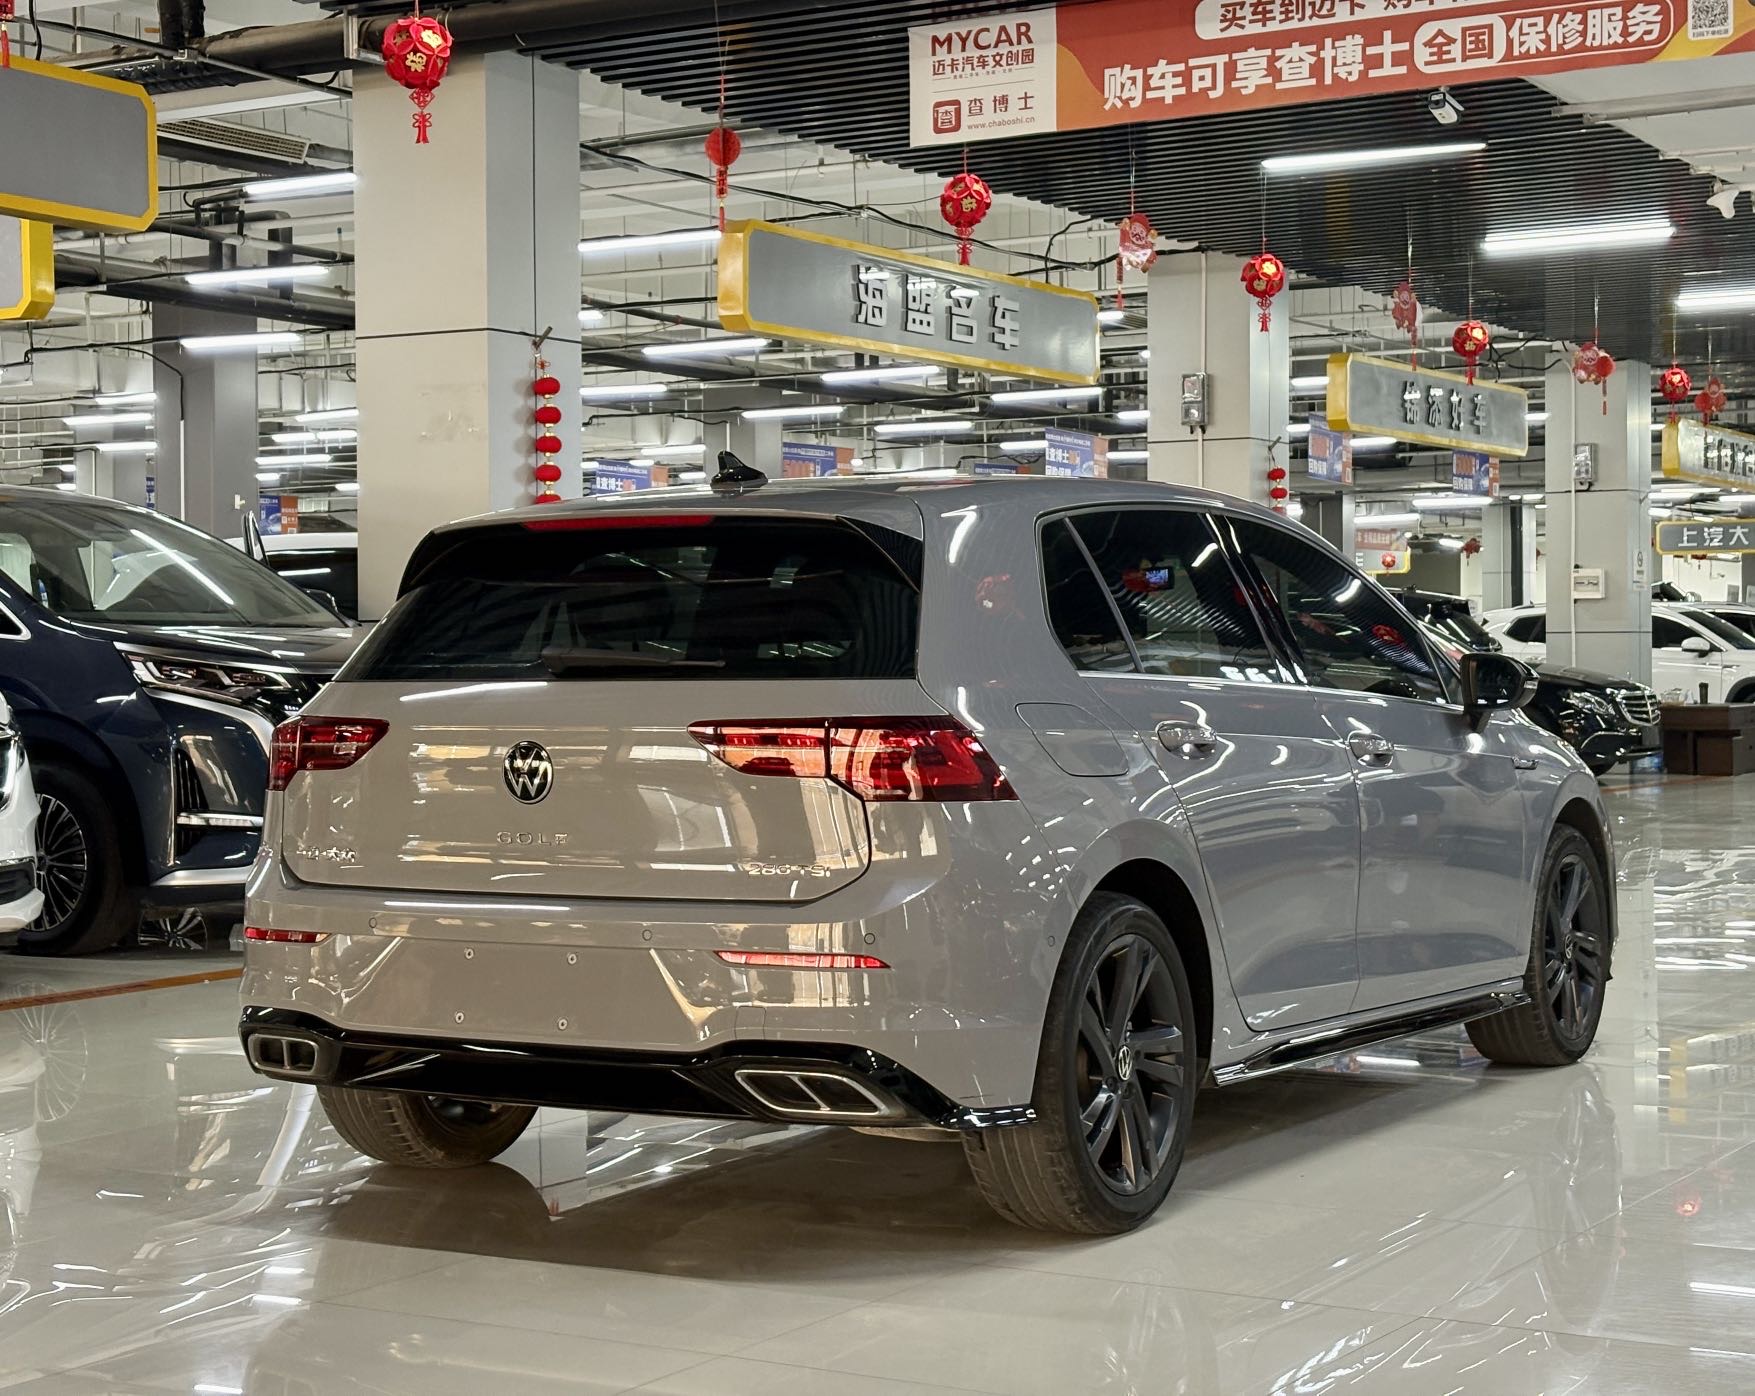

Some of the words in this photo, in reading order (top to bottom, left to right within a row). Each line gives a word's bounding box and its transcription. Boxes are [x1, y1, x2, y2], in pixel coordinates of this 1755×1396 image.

[931, 22, 1033, 56] MYCAR
[932, 48, 1034, 76] 迈卡汽车文创园
[967, 92, 1034, 117] 查博士
[967, 116, 1035, 130] www.chaboshi.cn
[497, 831, 568, 846] GOLF
